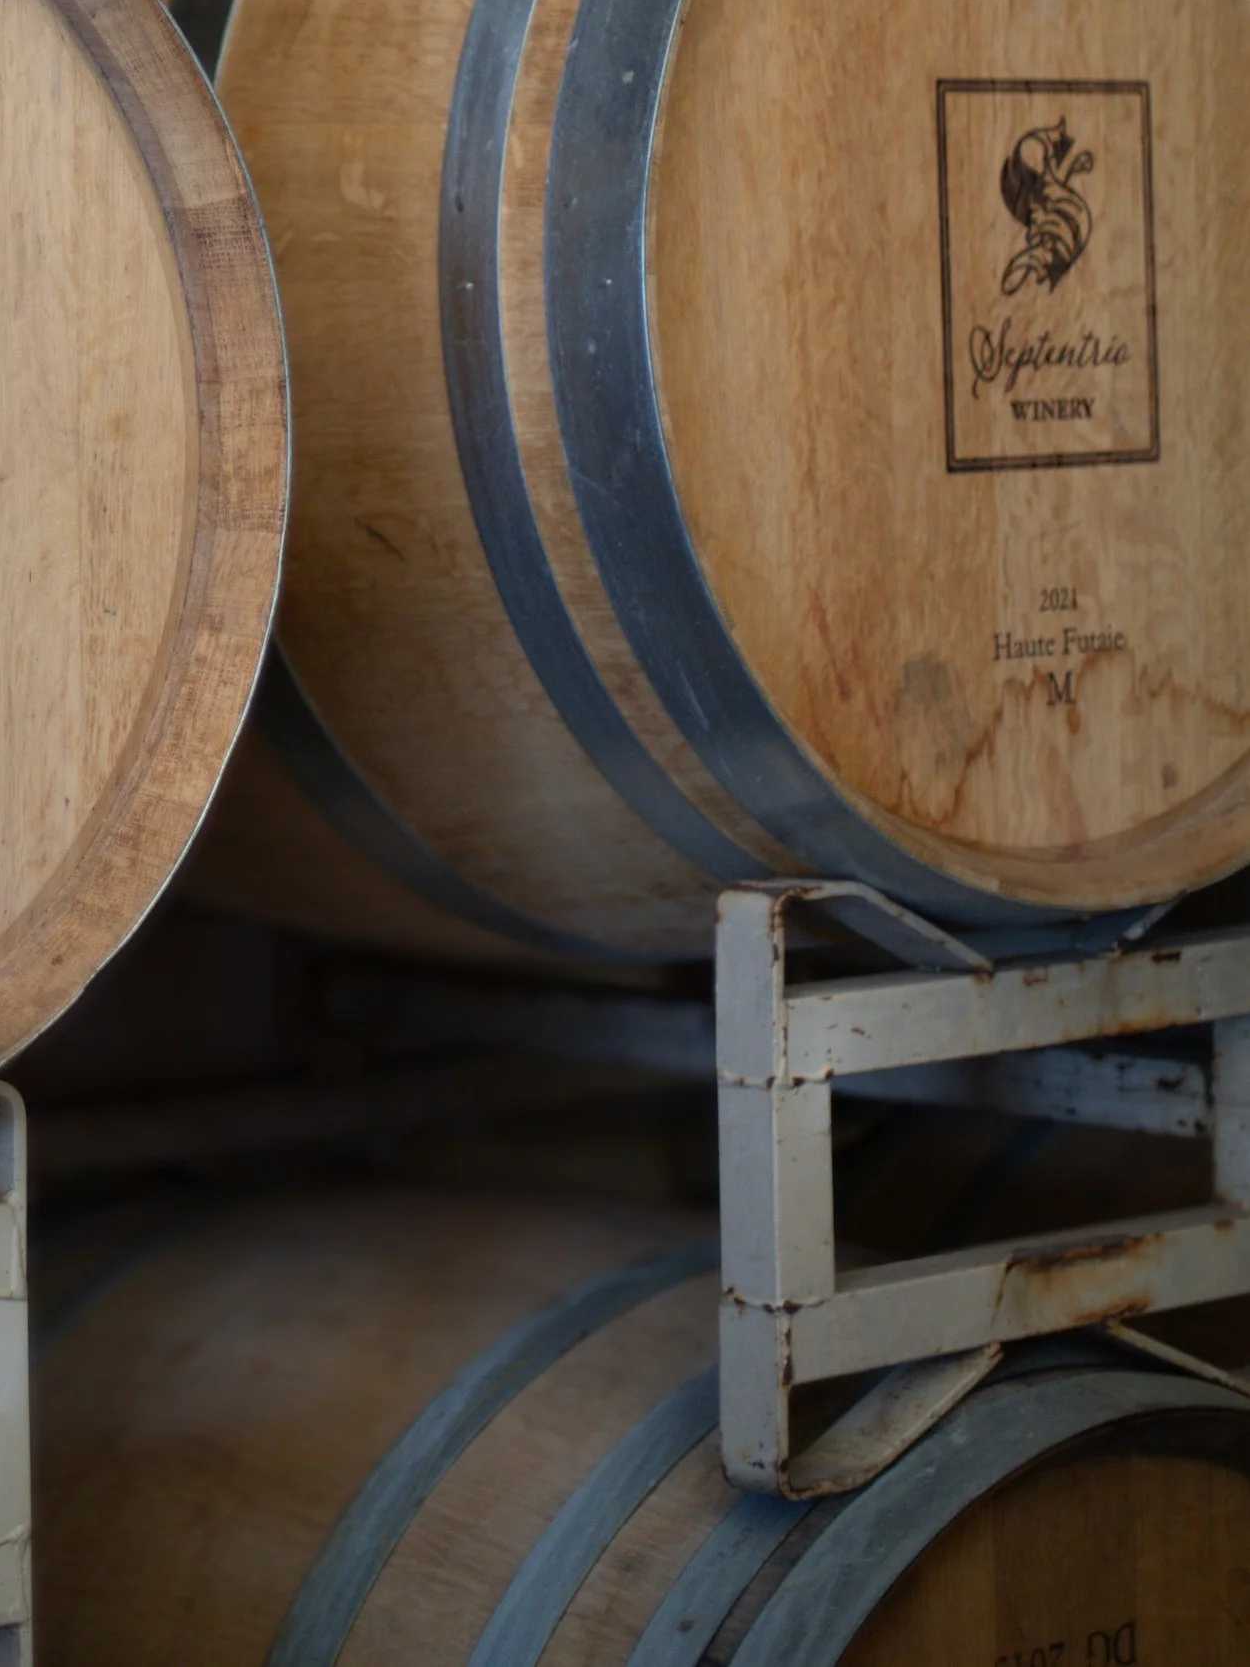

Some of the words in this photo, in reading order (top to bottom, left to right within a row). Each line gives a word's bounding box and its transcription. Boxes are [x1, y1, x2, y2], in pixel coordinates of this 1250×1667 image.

[969, 318, 1132, 399] Septentrio
[1010, 398, 1094, 423] WINERY
[1039, 586, 1079, 612] 2021
[993, 631, 1056, 661] Haute
[1062, 624, 1126, 656] Futaie
[1047, 670, 1075, 706] M
